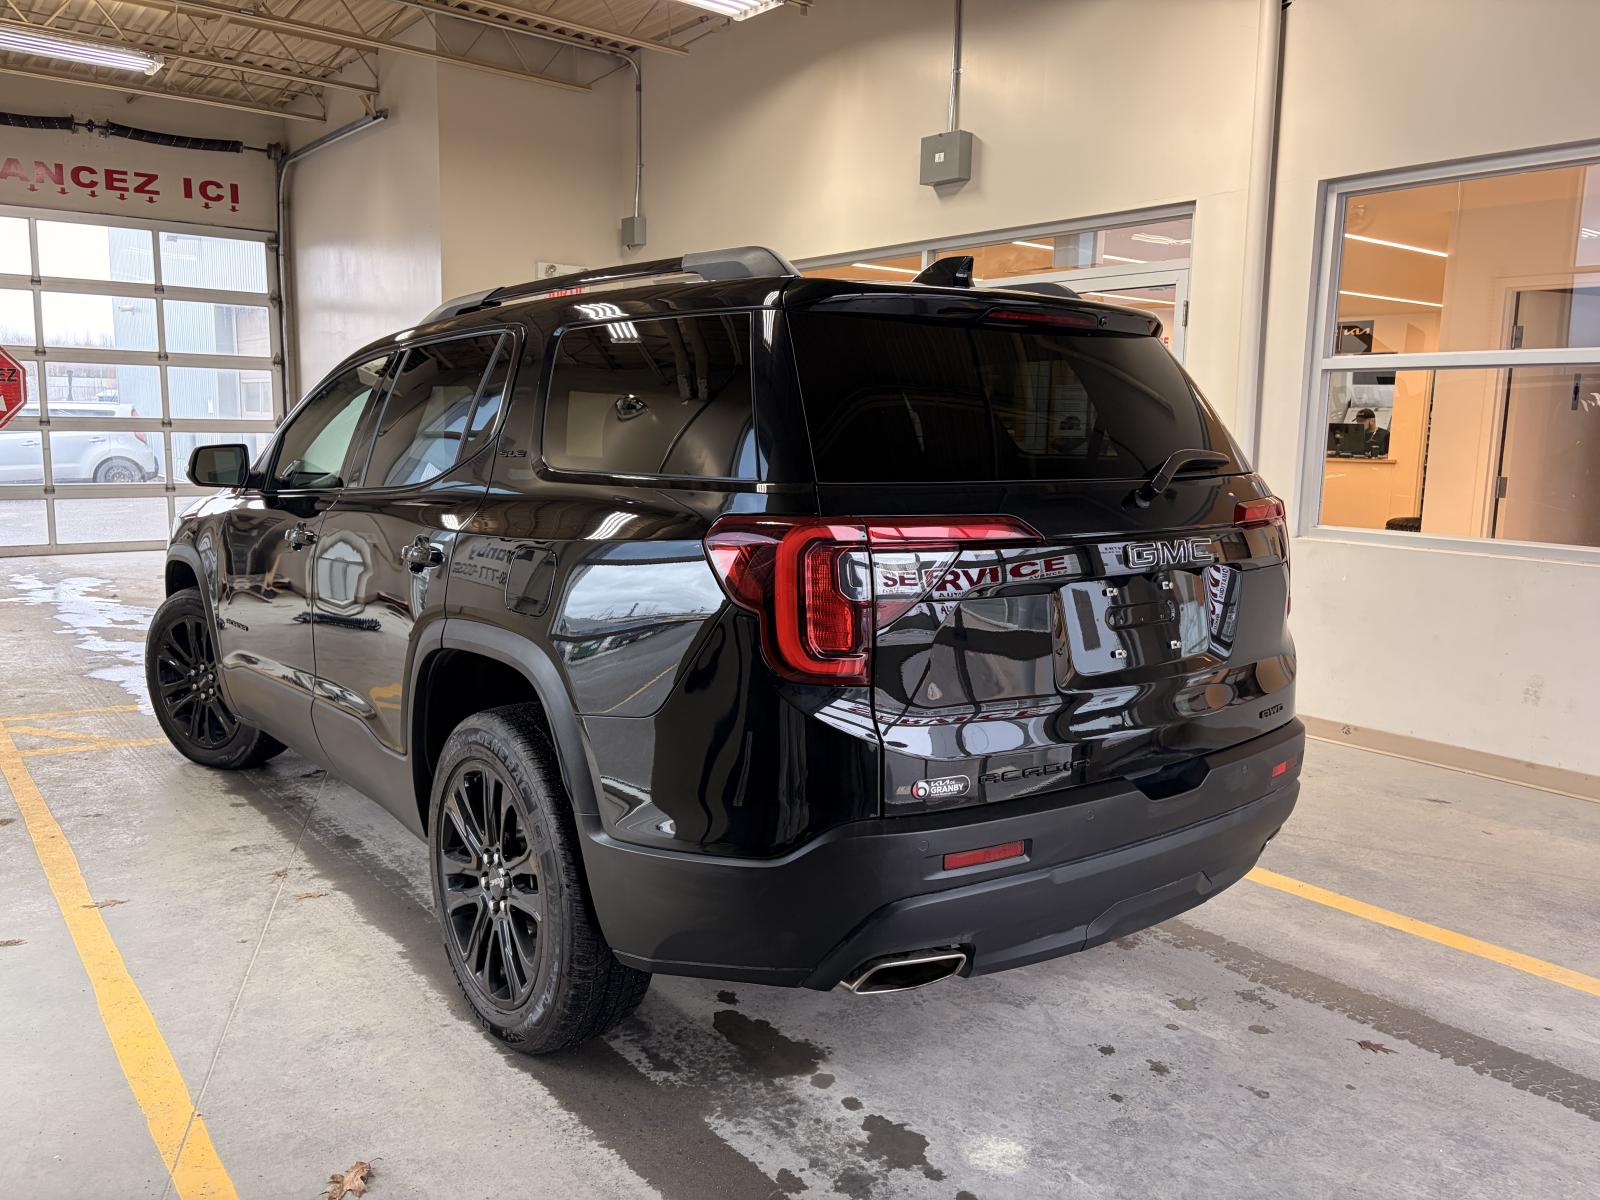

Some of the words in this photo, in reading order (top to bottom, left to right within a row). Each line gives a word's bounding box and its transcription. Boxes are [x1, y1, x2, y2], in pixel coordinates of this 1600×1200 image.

[0, 158, 160, 196] ANCEZ
[183, 177, 240, 205] ICI
[1126, 538, 1213, 569] GMC
[930, 782, 965, 794] GRANBY
